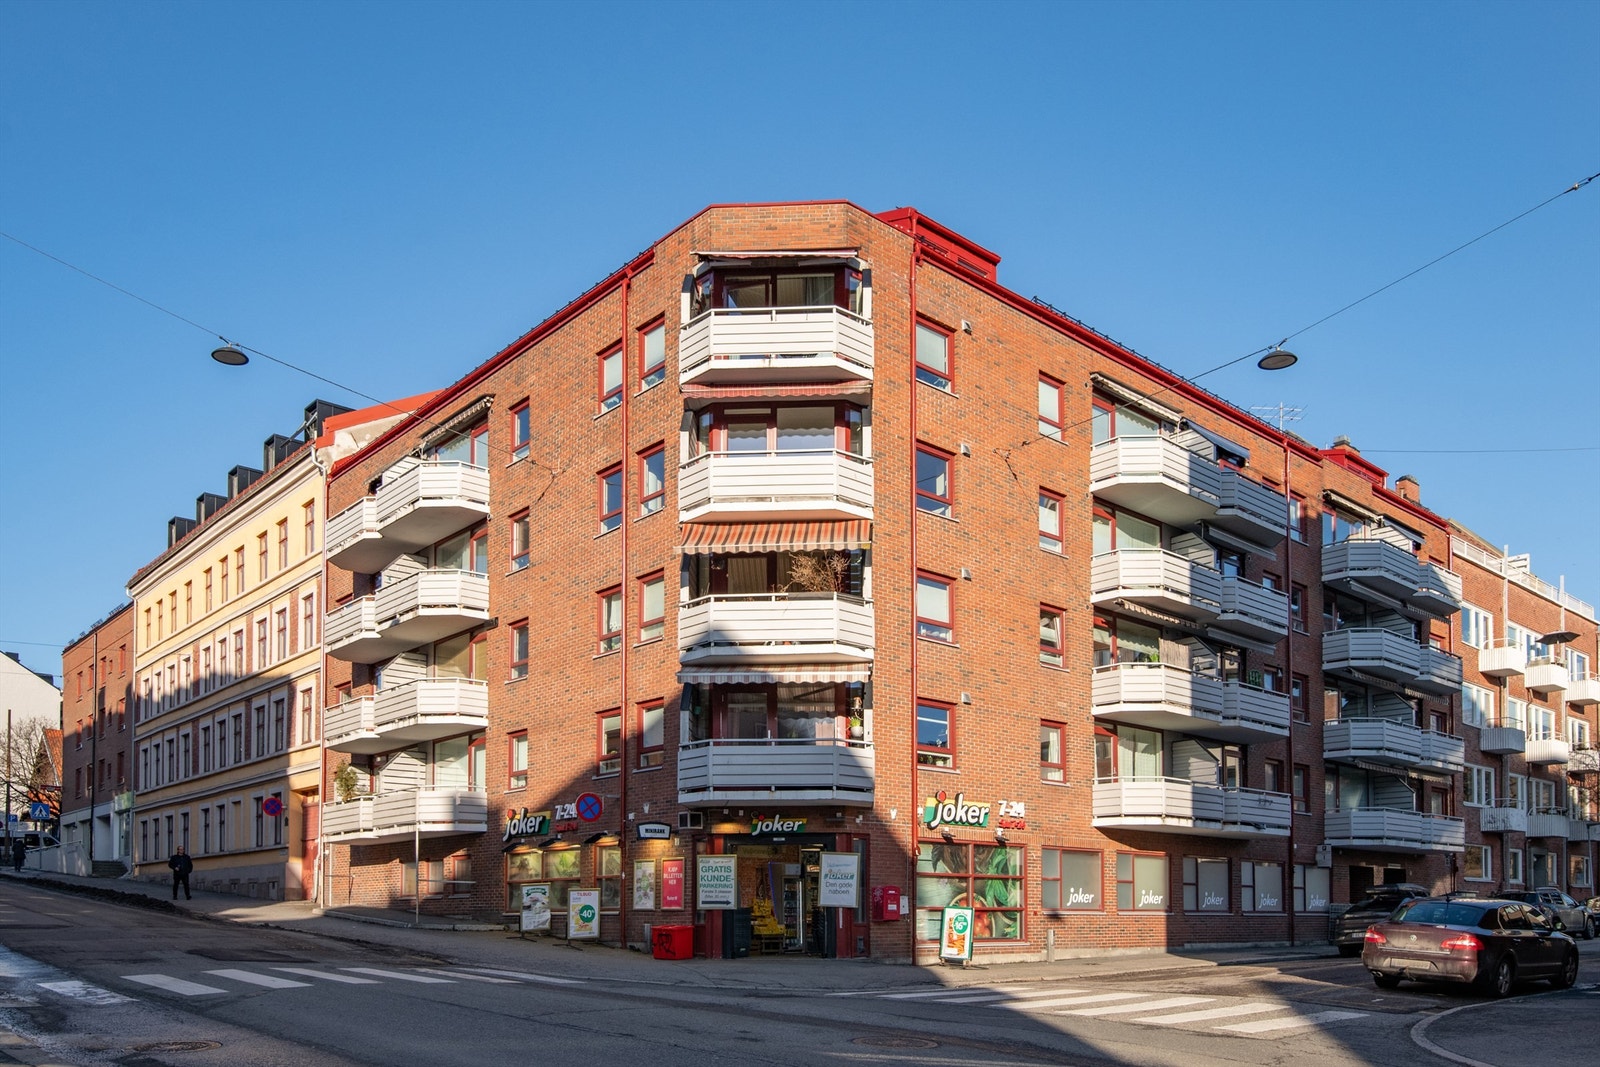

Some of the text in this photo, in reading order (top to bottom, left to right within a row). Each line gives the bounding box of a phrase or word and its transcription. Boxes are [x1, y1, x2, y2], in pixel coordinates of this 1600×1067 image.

[555, 803, 577, 820] 7-24
[930, 791, 989, 828] joker
[998, 800, 1025, 818] 7-24
[503, 807, 544, 841] joker
[752, 814, 803, 836] joker
[700, 865, 732, 873] GRATIS
[825, 868, 853, 880] joker
[1067, 887, 1095, 907] joker
[1139, 889, 1163, 908] joker
[1203, 891, 1224, 908] joker
[1259, 893, 1278, 908] joker
[1309, 894, 1326, 909] joker
